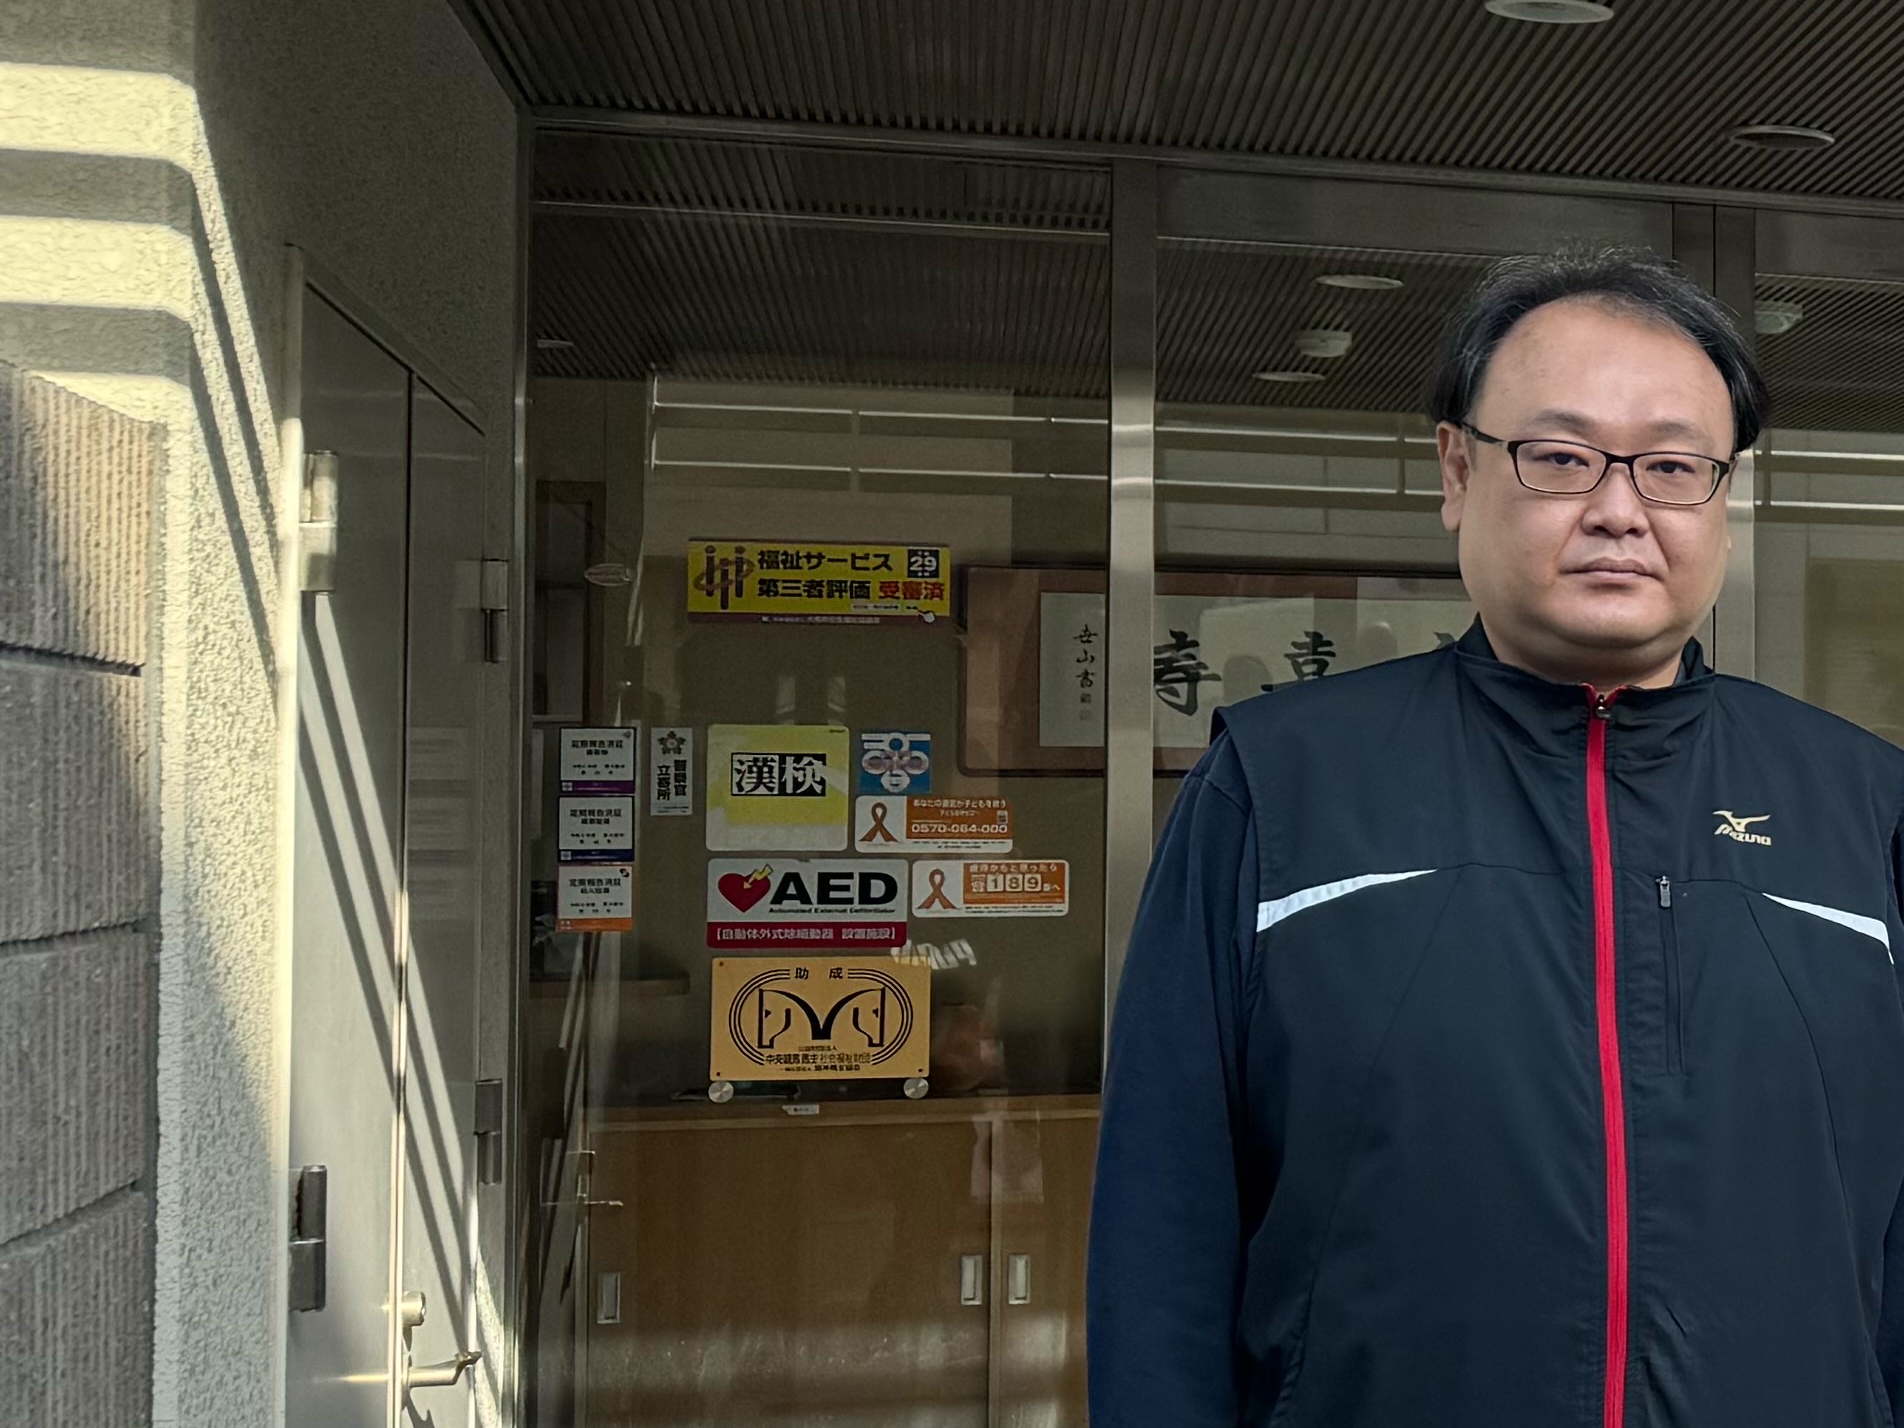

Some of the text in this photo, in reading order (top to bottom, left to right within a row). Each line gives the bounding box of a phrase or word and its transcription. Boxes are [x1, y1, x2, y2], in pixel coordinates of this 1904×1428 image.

[758, 549, 893, 572] 福祉サービス
[909, 555, 938, 571] 29
[757, 578, 945, 601] 第三者評価 受審済
[733, 755, 826, 796] 漢検
[769, 871, 898, 906] AED
[794, 967, 844, 980] 助成
